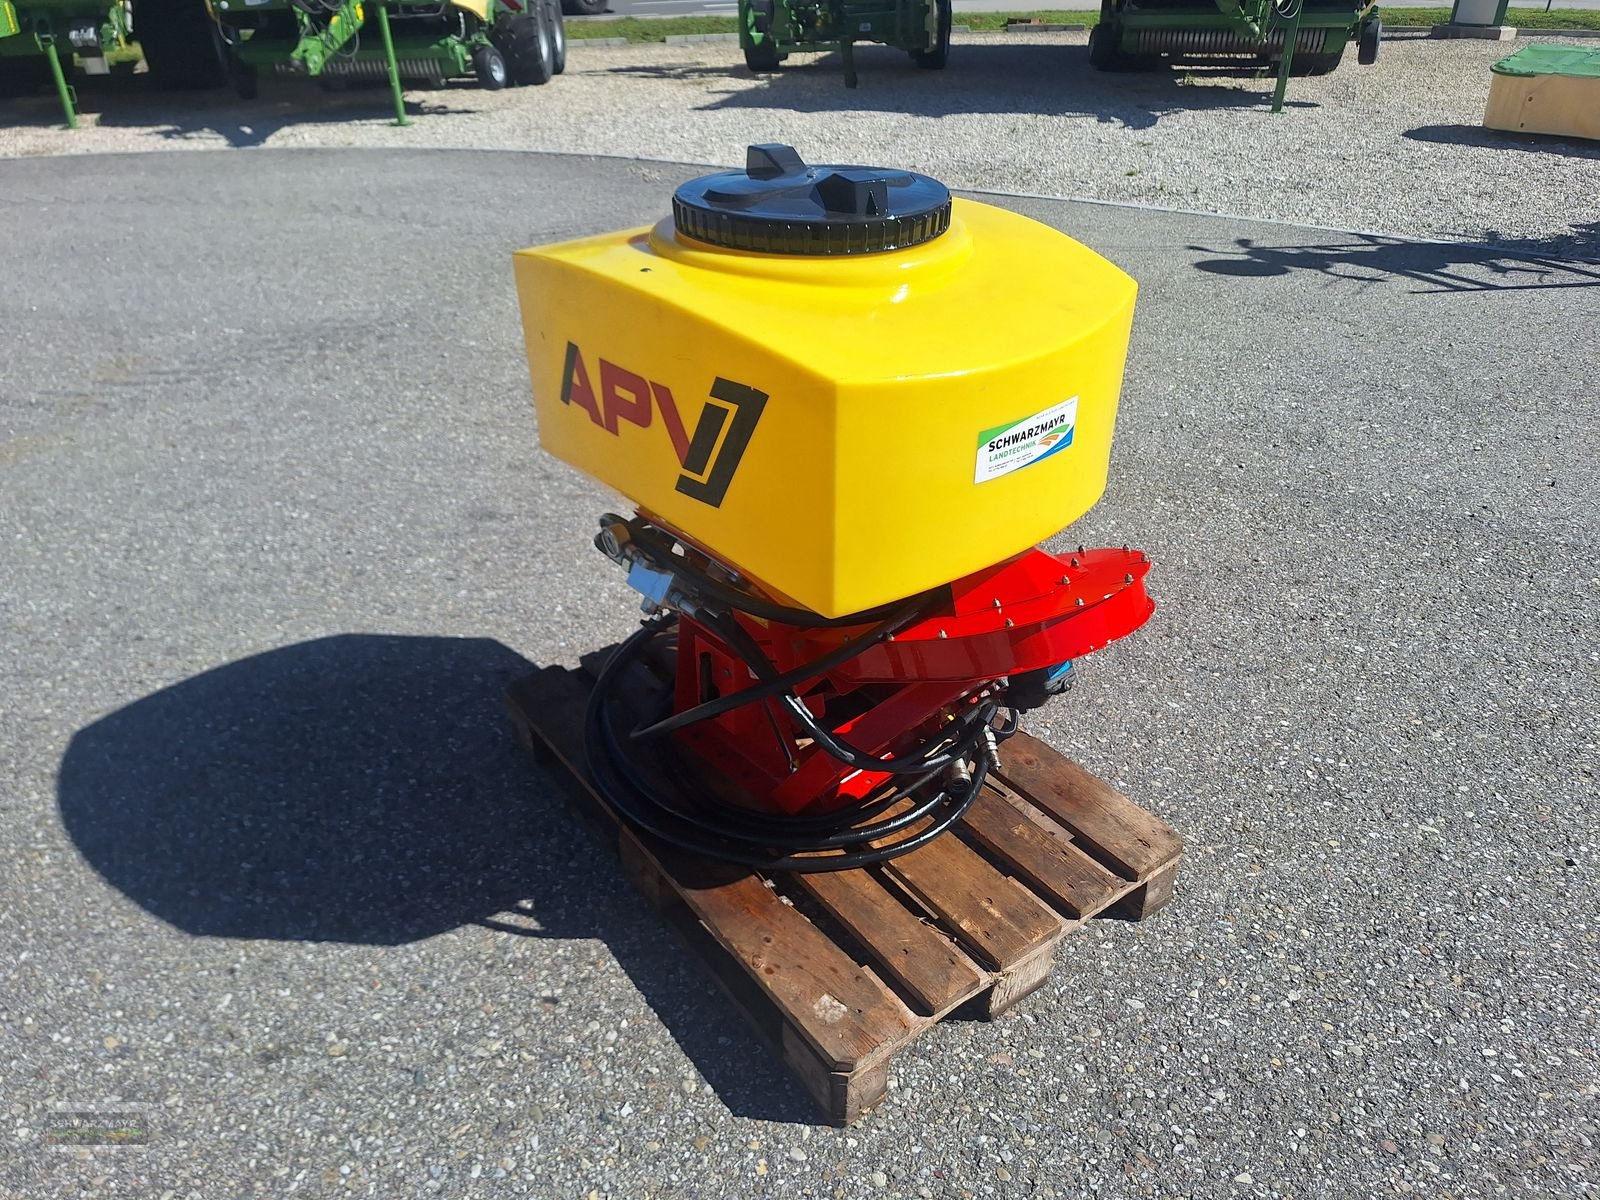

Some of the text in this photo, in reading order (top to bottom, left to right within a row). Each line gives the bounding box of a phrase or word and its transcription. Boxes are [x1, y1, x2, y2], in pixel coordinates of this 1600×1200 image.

[560, 341, 731, 480] APV
[988, 413, 1066, 453] SCHWARZMAYR
[988, 439, 1037, 463] LANDTECHNIK
